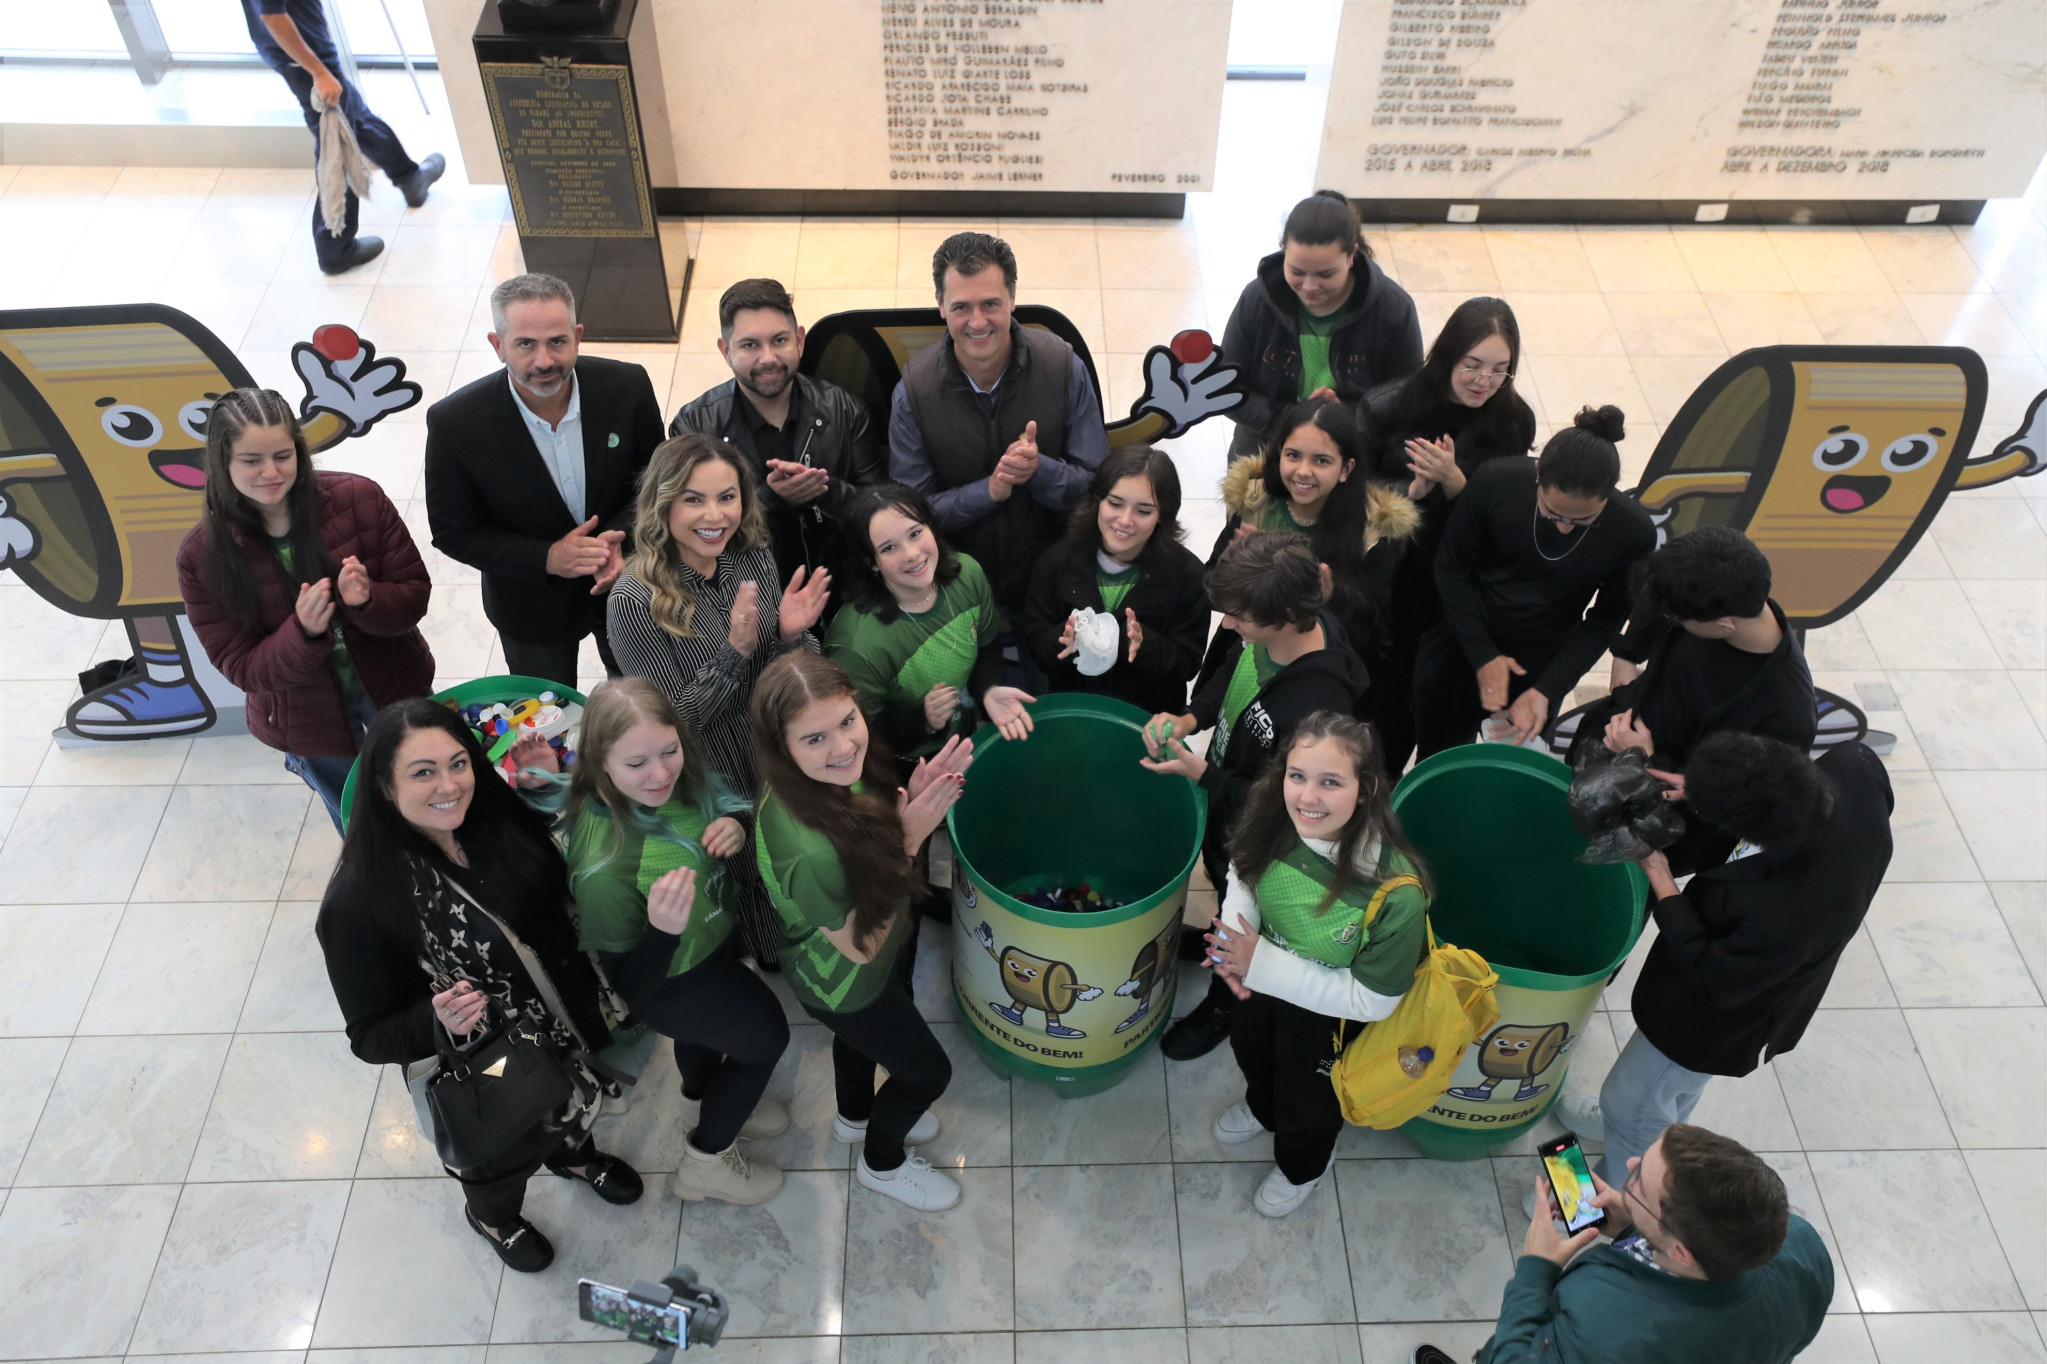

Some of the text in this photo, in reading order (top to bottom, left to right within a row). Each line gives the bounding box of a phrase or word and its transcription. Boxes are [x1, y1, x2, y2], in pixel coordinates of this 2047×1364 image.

[922, 4, 979, 14] ANTONIO
[923, 18, 955, 28] ALVES
[960, 18, 974, 28] DE
[1390, 24, 1445, 34] GILBERTO
[883, 31, 940, 40] ORLANDO
[1438, 38, 1451, 47] DE
[1456, 38, 1495, 48] SOUZA
[936, 44, 949, 54] DE
[1384, 50, 1417, 60] GUTO
[930, 130, 942, 140] DE
[1367, 144, 1471, 156] GOVERNADOR:
[1726, 146, 1836, 158] GOVERNADORA:
[1404, 160, 1413, 172] A
[1420, 160, 1454, 172] ABRIL
[1760, 162, 1769, 173] A
[1776, 162, 1848, 174] DEZEMBRO
[890, 170, 1043, 182] GOVERNADOR JAIME LERNER
[1112, 173, 1200, 184] FEVEREIRO 2001
[1013, 1037, 1038, 1052] DO
[1040, 1047, 1084, 1059] BEM!
[1468, 1114, 1497, 1122] DO
[1500, 1104, 1539, 1122] BEM!
